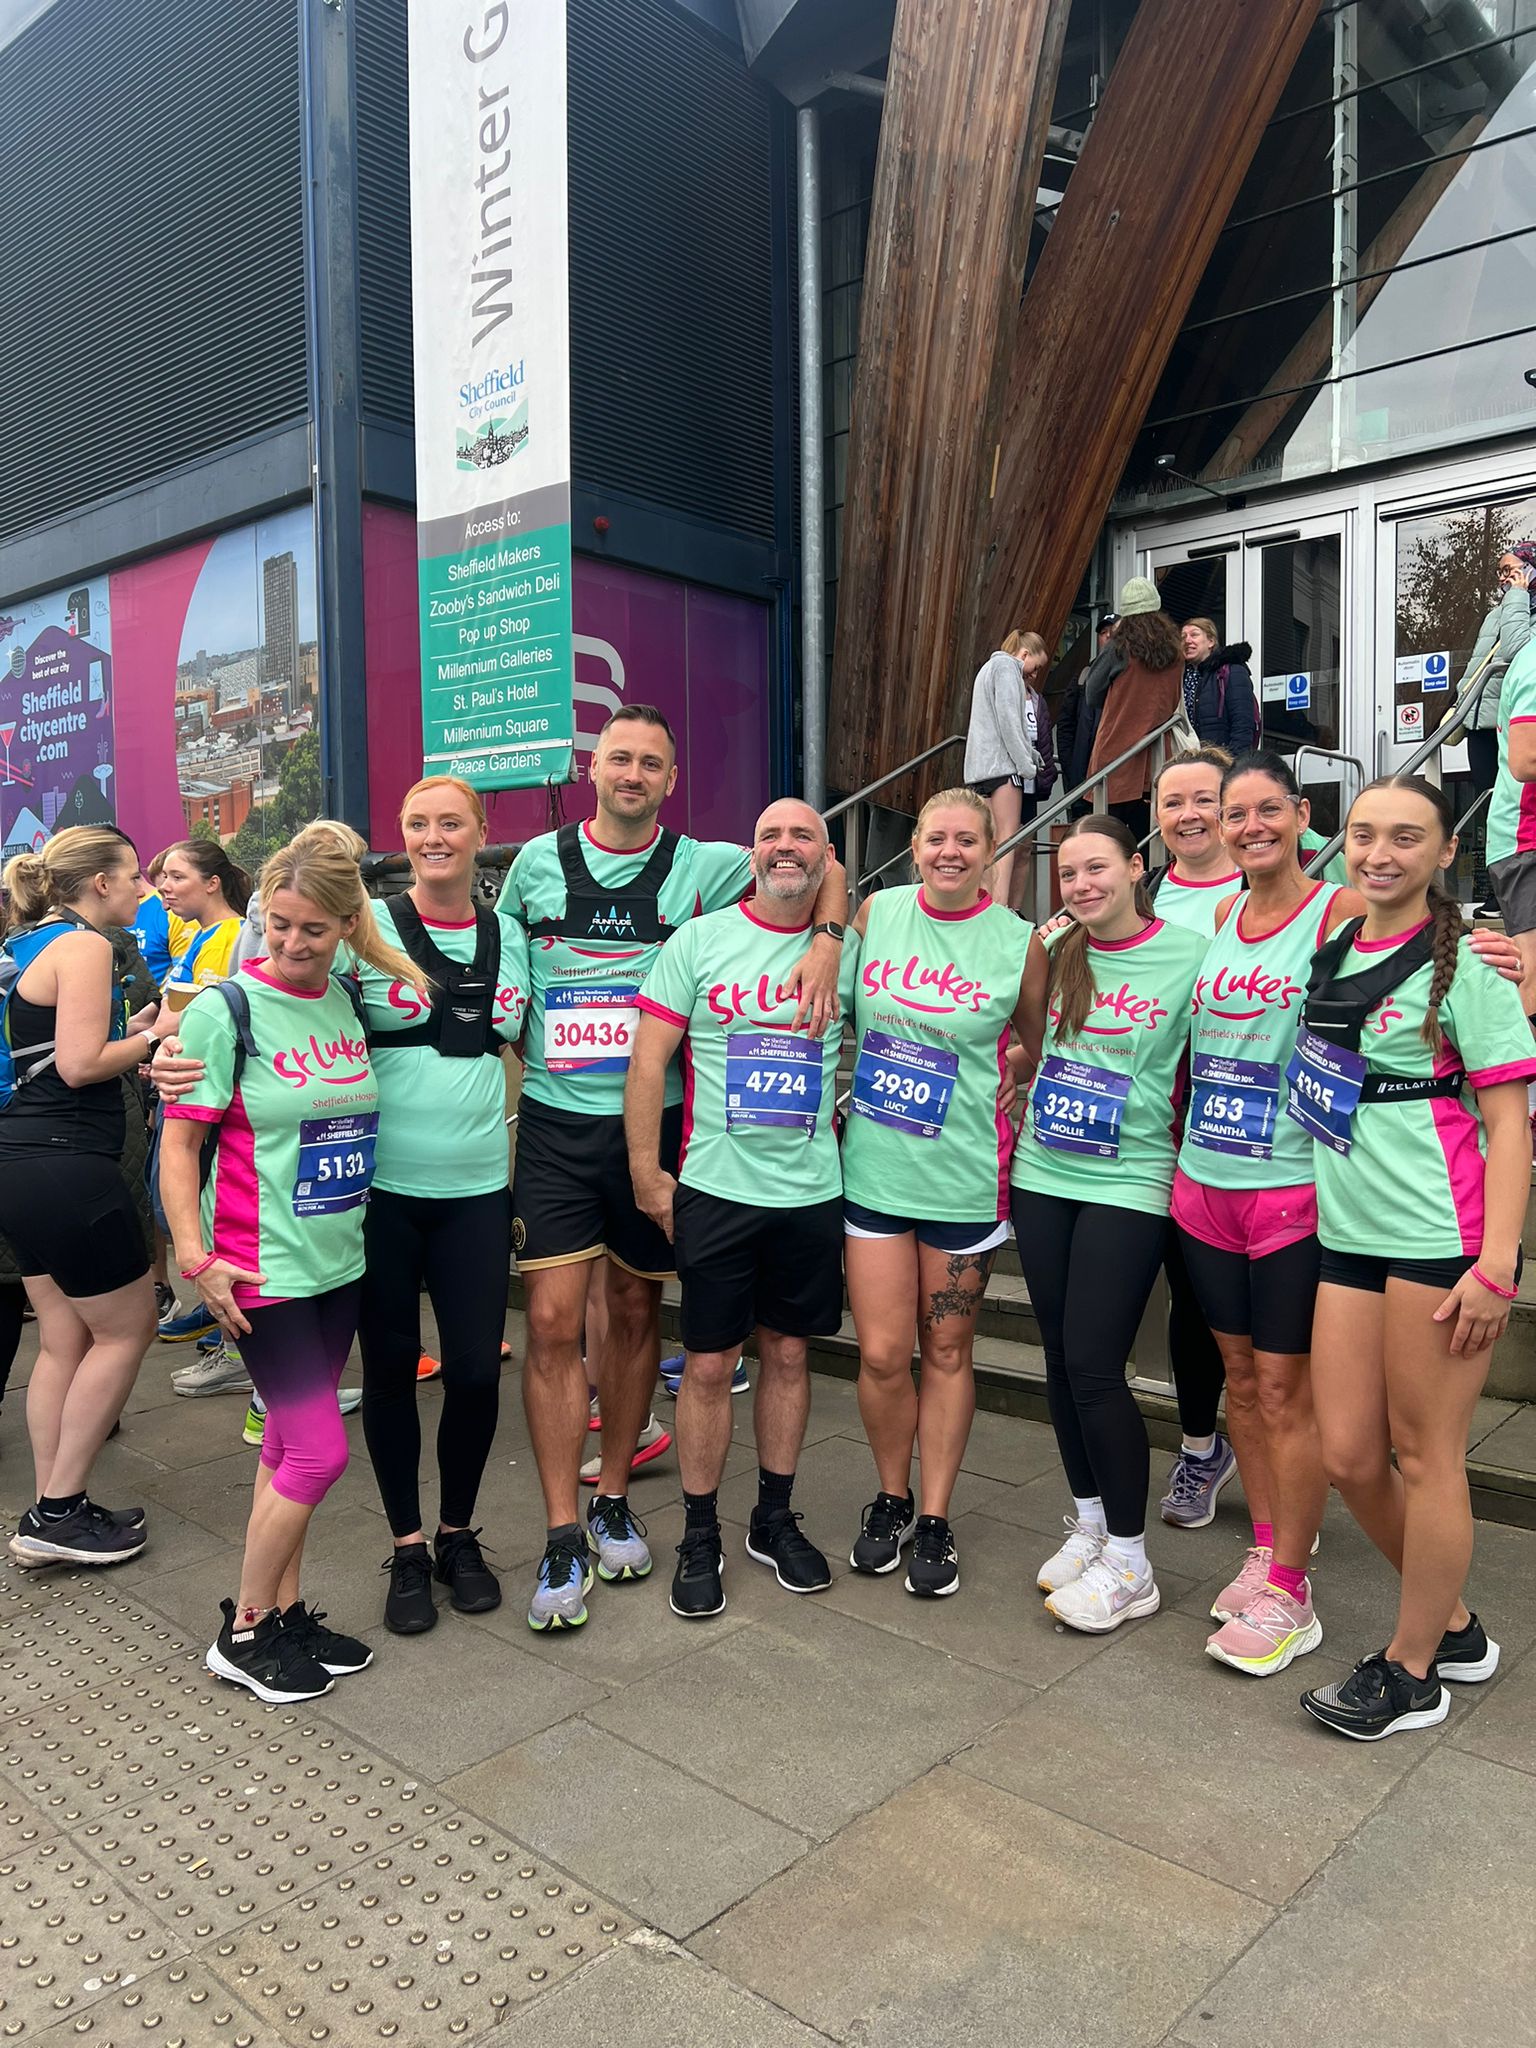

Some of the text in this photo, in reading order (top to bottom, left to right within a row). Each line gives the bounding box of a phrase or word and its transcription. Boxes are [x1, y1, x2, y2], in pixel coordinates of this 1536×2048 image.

[471, 85, 513, 348] Winter
[459, 360, 524, 408] Sheffield
[469, 392, 516, 420] City Council
[465, 510, 521, 539] Access to:
[448, 545, 541, 581] Sheffield Makers
[430, 572, 560, 617] Zooby's Sandwich Deli
[459, 617, 530, 645] Pop up Shop
[35, 649, 66, 666] Discover the
[438, 647, 552, 680] Millennium Galleries
[32, 662, 70, 680] best of our city
[22, 680, 82, 715] Sheffield
[453, 681, 538, 711] St. Paul's Hotel
[20, 712, 87, 744] citycentre
[444, 717, 549, 744] Millennium Square
[36, 741, 68, 762] .com
[449, 752, 541, 775] Peace Gardens
[592, 918, 632, 926] RUNITUDE
[862, 956, 991, 1012] St Luke's
[1212, 964, 1302, 1010] Luke's
[708, 983, 752, 1025] St
[1088, 983, 1168, 1030] uke's
[554, 1022, 629, 1047] 30436
[919, 1022, 957, 1040] Hospice
[1199, 1028, 1271, 1044] Sheffield's Hospice
[760, 1049, 795, 1057] SHEFFIELD
[890, 1051, 937, 1069] SHEFFIELD 10K
[1328, 1060, 1341, 1072] 10K
[273, 1048, 315, 1088] St
[1208, 1070, 1255, 1083] SHEFFIELD 10K
[746, 1071, 807, 1095] 4724
[870, 1069, 931, 1105] 2930
[1062, 1073, 1107, 1090] SHEFFIELD 10K
[1388, 1080, 1438, 1092] ZELAFIT
[312, 1095, 354, 1110] Sheffield's
[884, 1100, 908, 1113] LUCY
[1044, 1092, 1098, 1124] 3231
[1203, 1094, 1245, 1122] 653
[327, 1129, 357, 1140] SHEFFIELD
[1050, 1122, 1085, 1137] MOLLIE
[1199, 1121, 1247, 1138] SAMANTHA
[317, 1151, 366, 1182] 5132
[231, 1630, 255, 1644] PUMA
